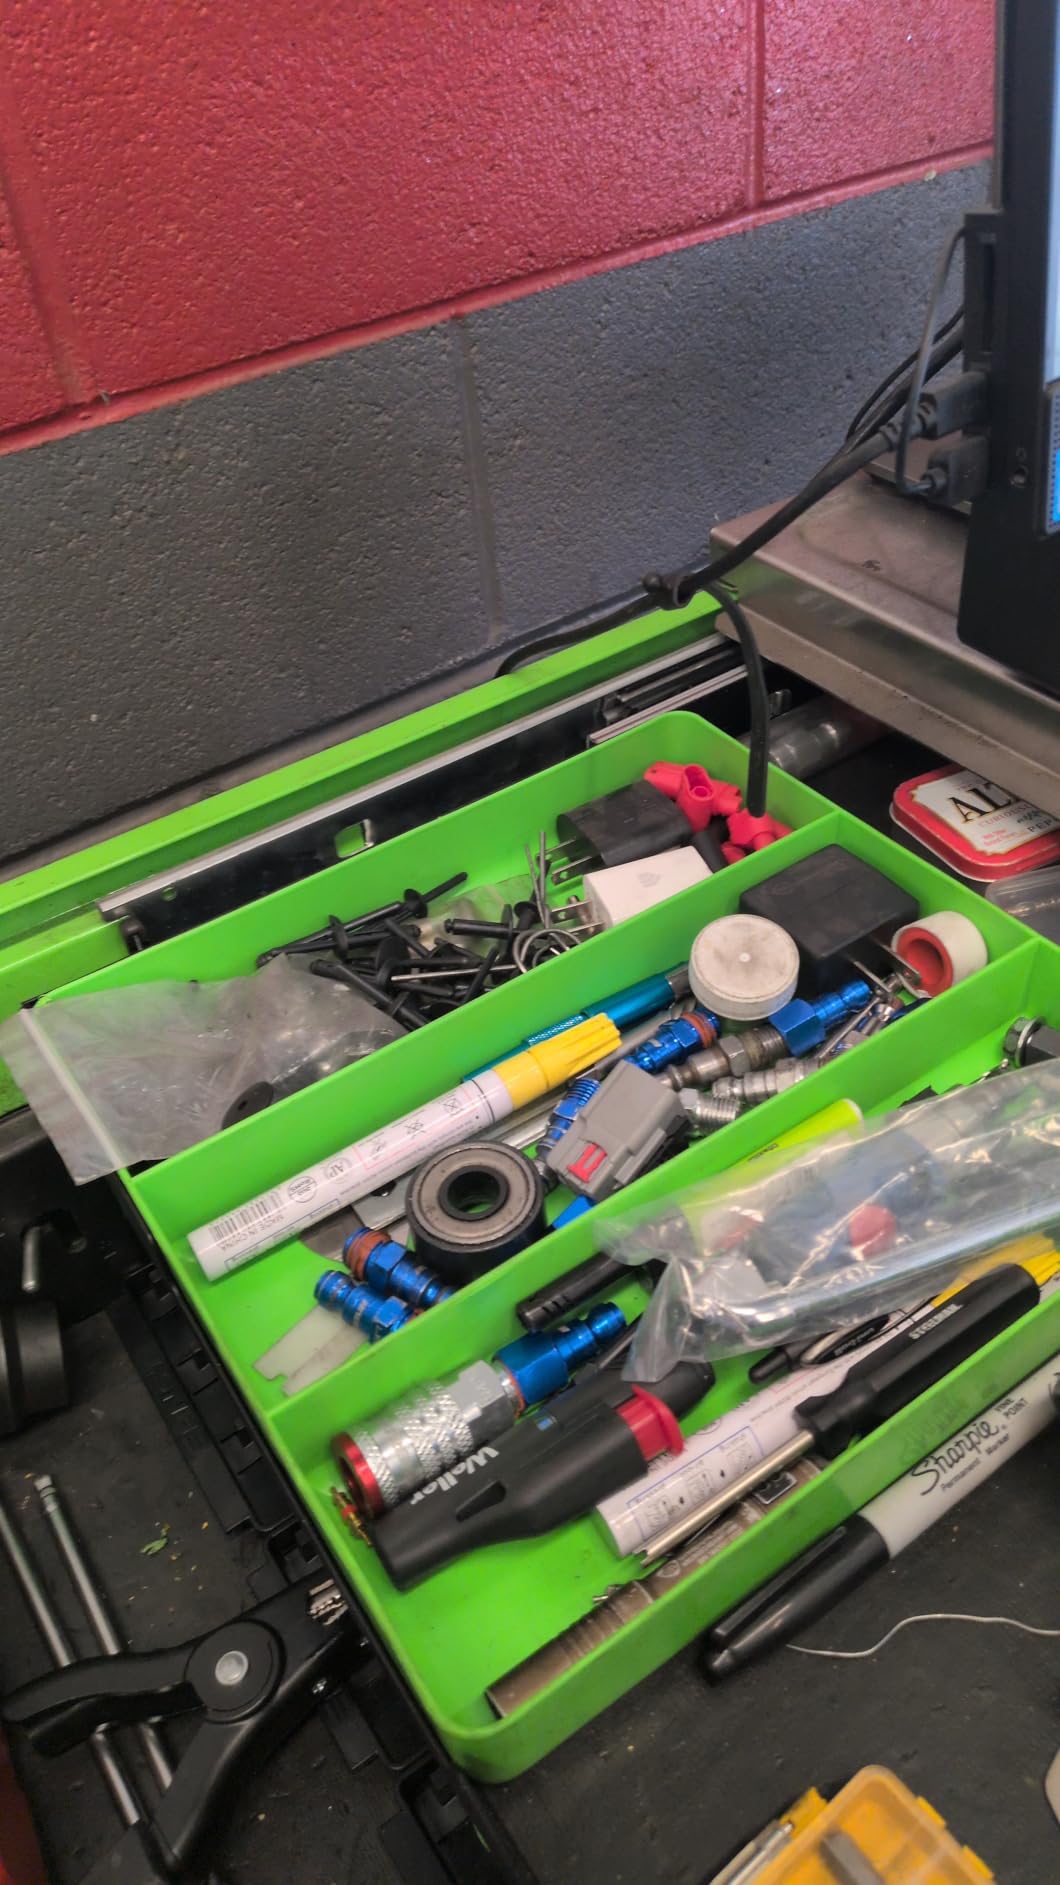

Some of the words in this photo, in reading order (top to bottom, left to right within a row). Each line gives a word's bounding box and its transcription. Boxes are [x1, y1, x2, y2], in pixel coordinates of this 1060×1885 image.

[258, 1213, 284, 1231] MADE
[220, 1234, 248, 1252] CHINA
[909, 1304, 961, 1340] STEELMAN
[995, 1398, 1014, 1412] FINE
[1003, 1397, 1028, 1419] POINT
[911, 1420, 999, 1495] Sharpie
[940, 1457, 982, 1492] Permanent
[985, 1433, 1010, 1456] Marker
[410, 1446, 499, 1505] Weller
